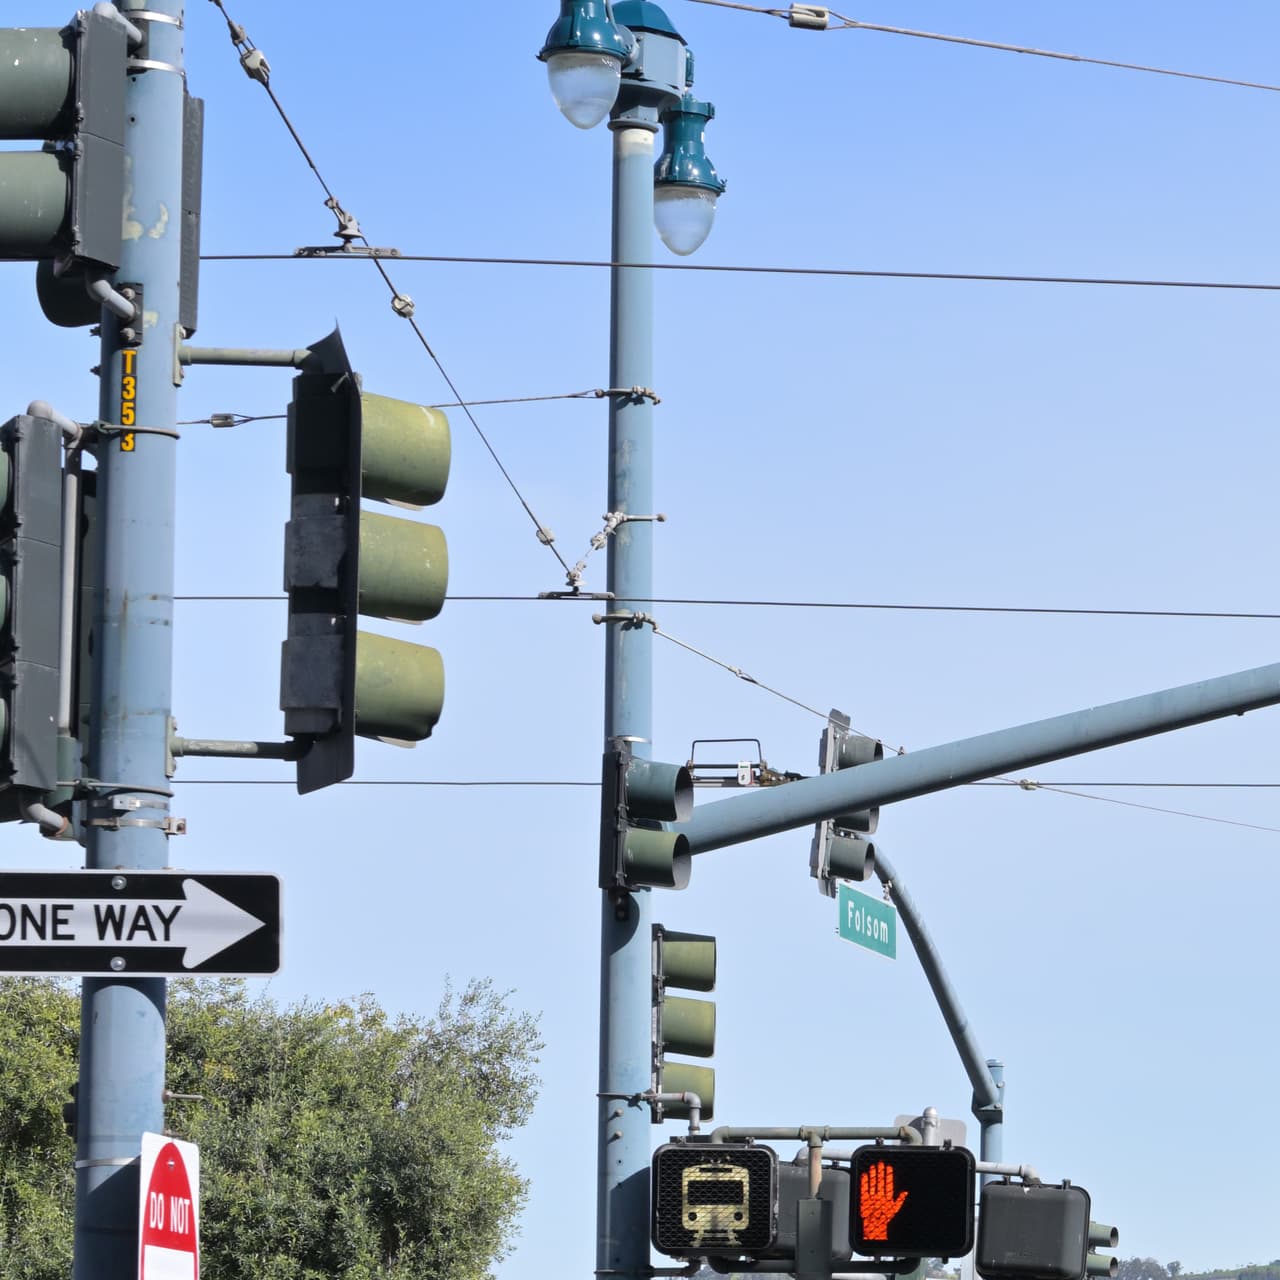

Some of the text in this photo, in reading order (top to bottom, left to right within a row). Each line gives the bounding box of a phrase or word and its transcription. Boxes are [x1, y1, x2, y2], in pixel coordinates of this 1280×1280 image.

[0, 903, 183, 942] ONE WAY
[847, 900, 889, 944] Folsom
[149, 1191, 191, 1235] DO NOT
